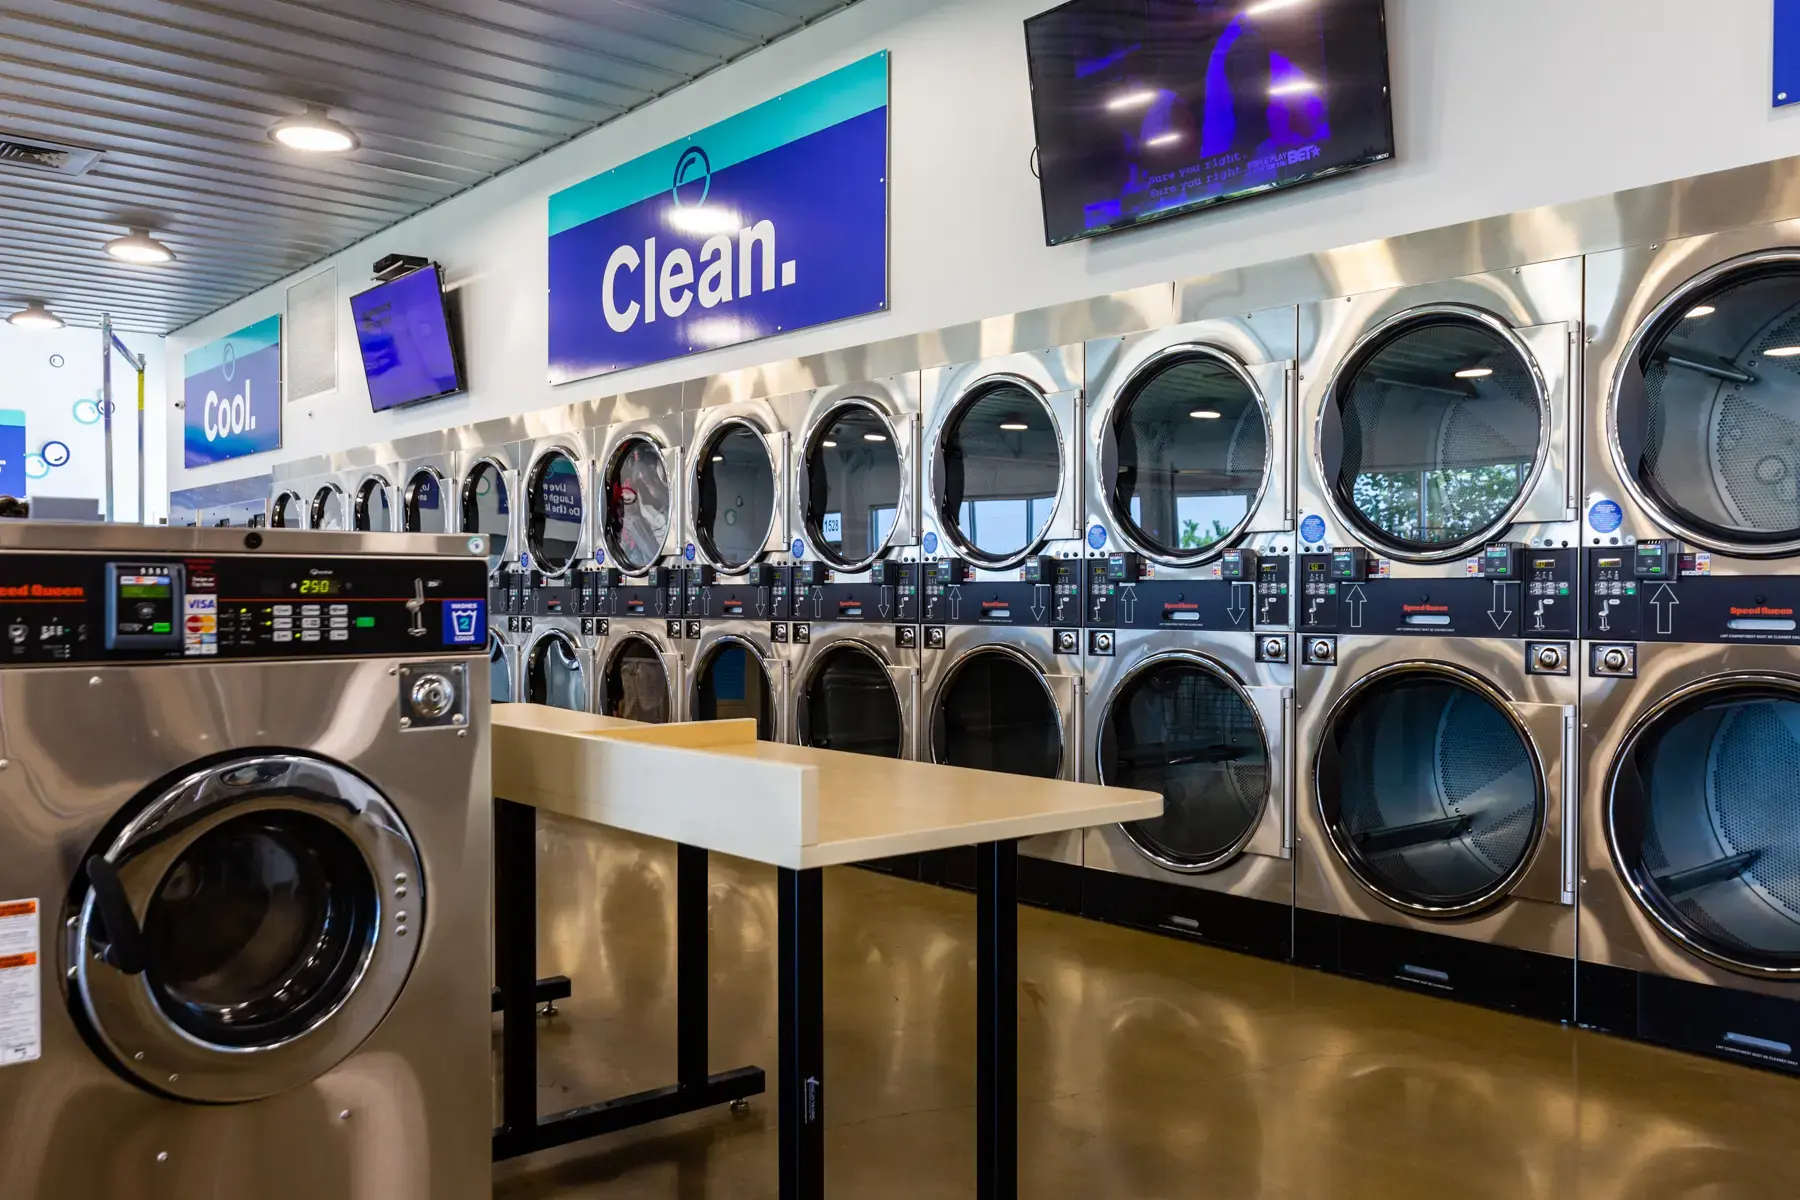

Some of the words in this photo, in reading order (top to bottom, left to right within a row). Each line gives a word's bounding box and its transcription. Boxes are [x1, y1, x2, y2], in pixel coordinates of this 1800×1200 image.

[1287, 145, 1313, 165] BET
[1149, 172, 1175, 185] Sure
[1179, 165, 1200, 178] you
[1180, 178, 1202, 192] you
[602, 219, 796, 332] Clean.
[204, 379, 256, 442] Cool.
[31, 584, 84, 597] Queen
[187, 599, 216, 609] VISA
[1730, 606, 1760, 615] Speed
[1761, 606, 1793, 615] Queen
[459, 617, 470, 630] 2
